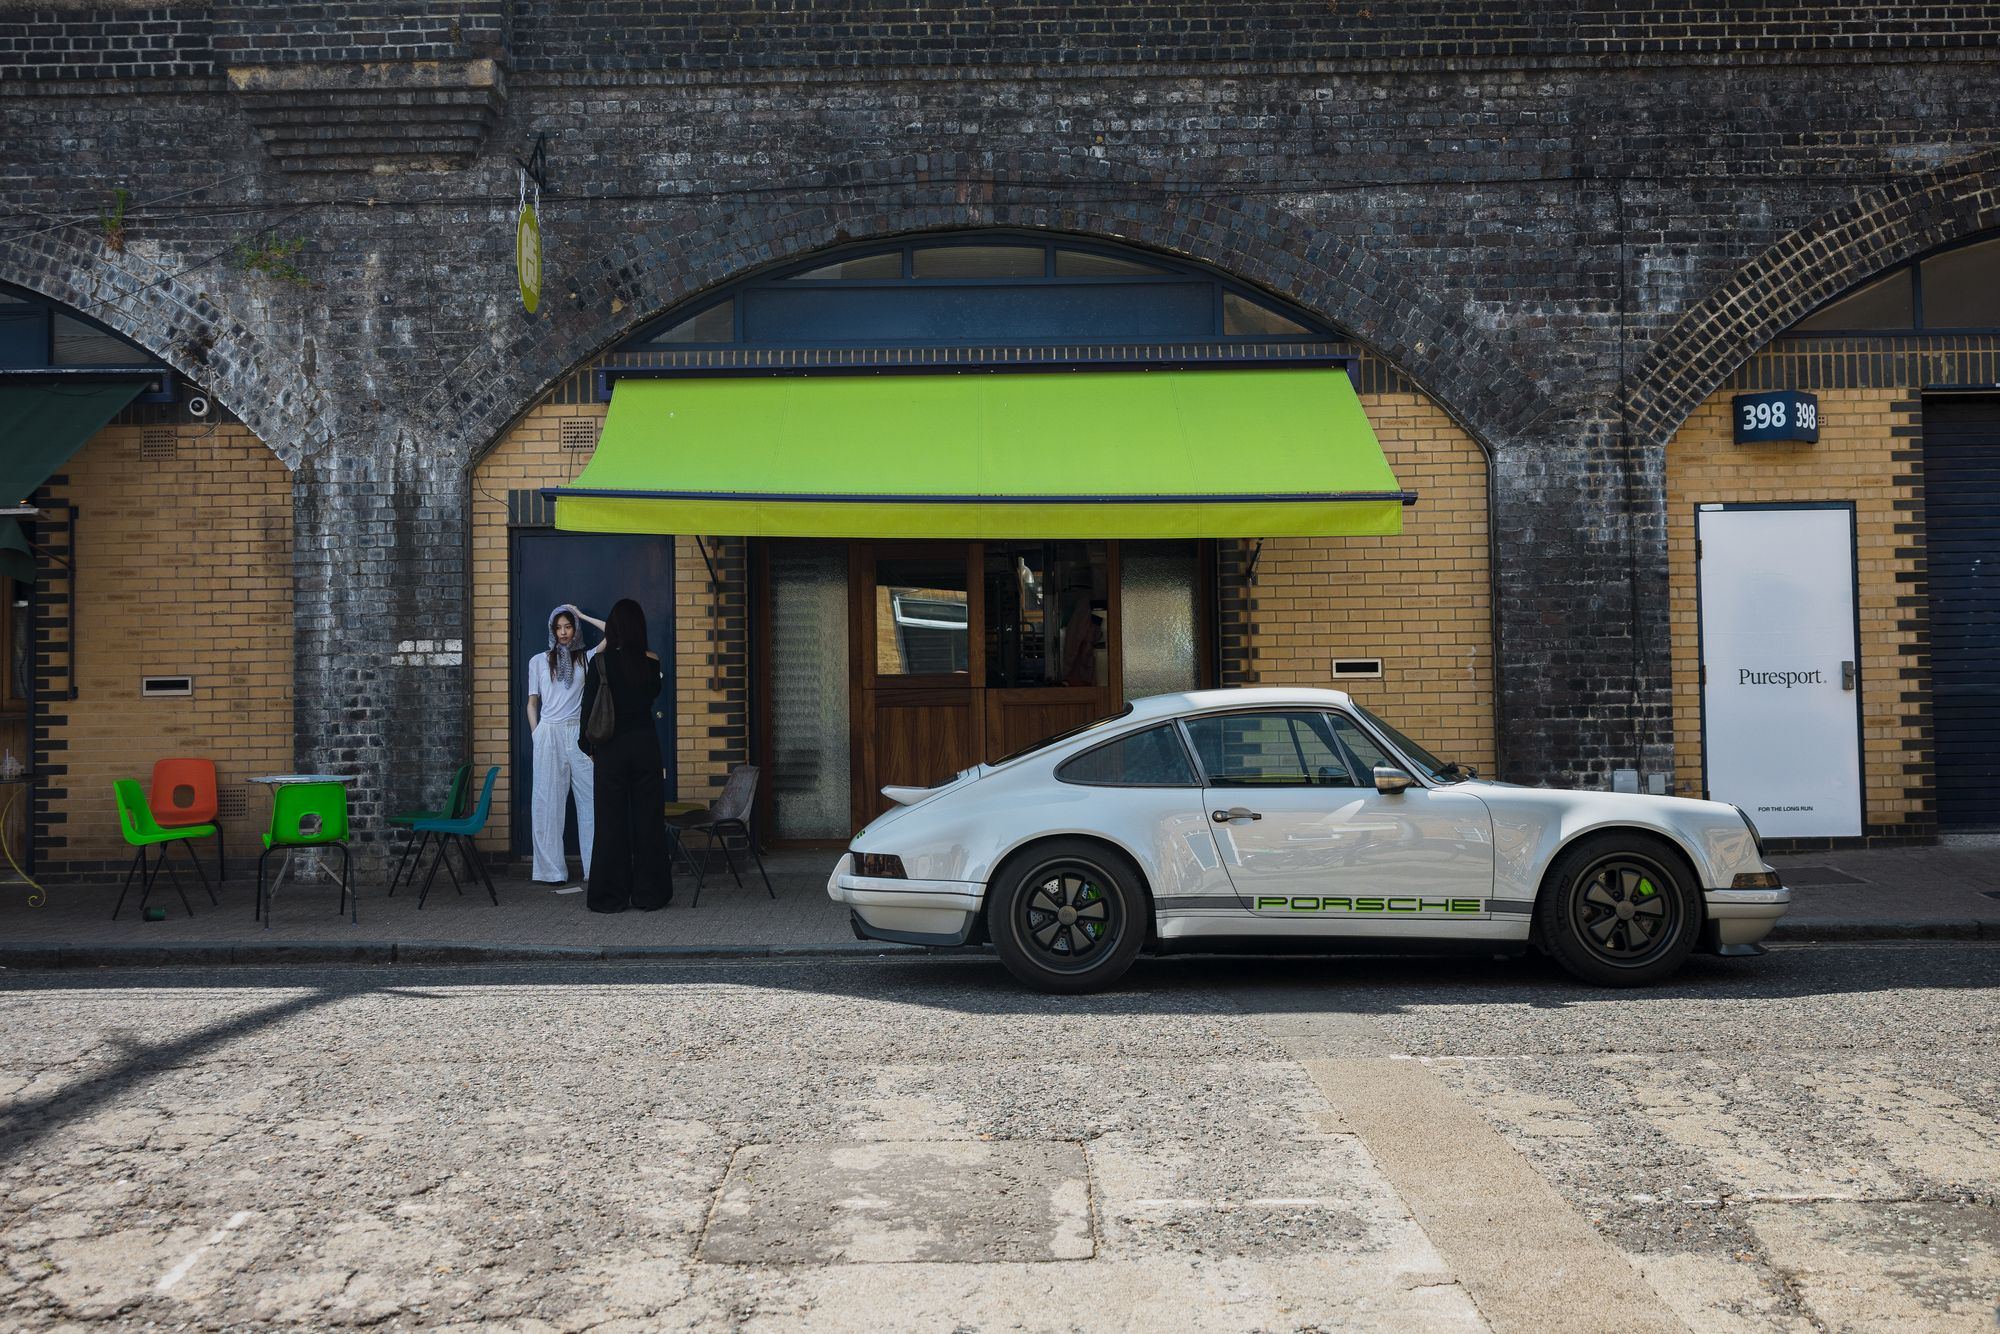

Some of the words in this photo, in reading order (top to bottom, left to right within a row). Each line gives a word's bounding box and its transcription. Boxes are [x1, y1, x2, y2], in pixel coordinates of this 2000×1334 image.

[1743, 402, 1786, 430] 398
[1796, 402, 1816, 430] 398
[1257, 896, 1481, 913] PORSCHE
